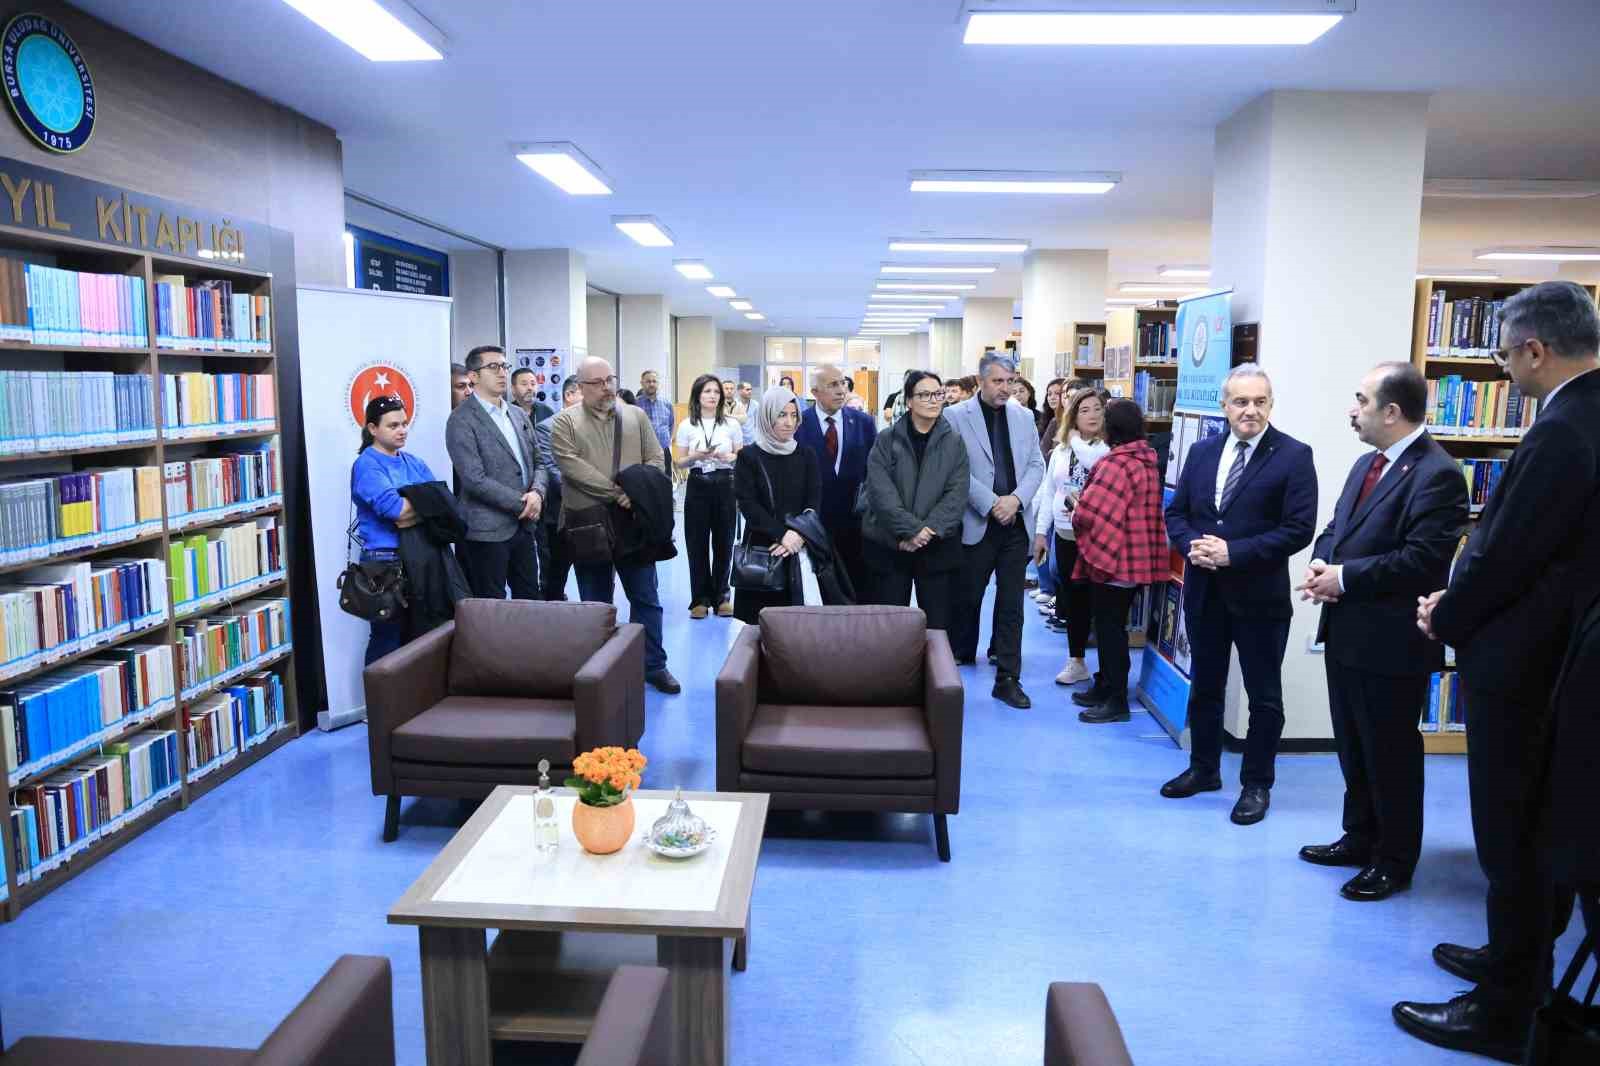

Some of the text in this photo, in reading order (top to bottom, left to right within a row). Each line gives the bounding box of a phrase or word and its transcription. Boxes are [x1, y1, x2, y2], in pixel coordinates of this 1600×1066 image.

[4, 45, 20, 98] BURSA
[43, 131, 72, 149] 1975
[0, 172, 244, 262] YIL KİTAPLIĞI
